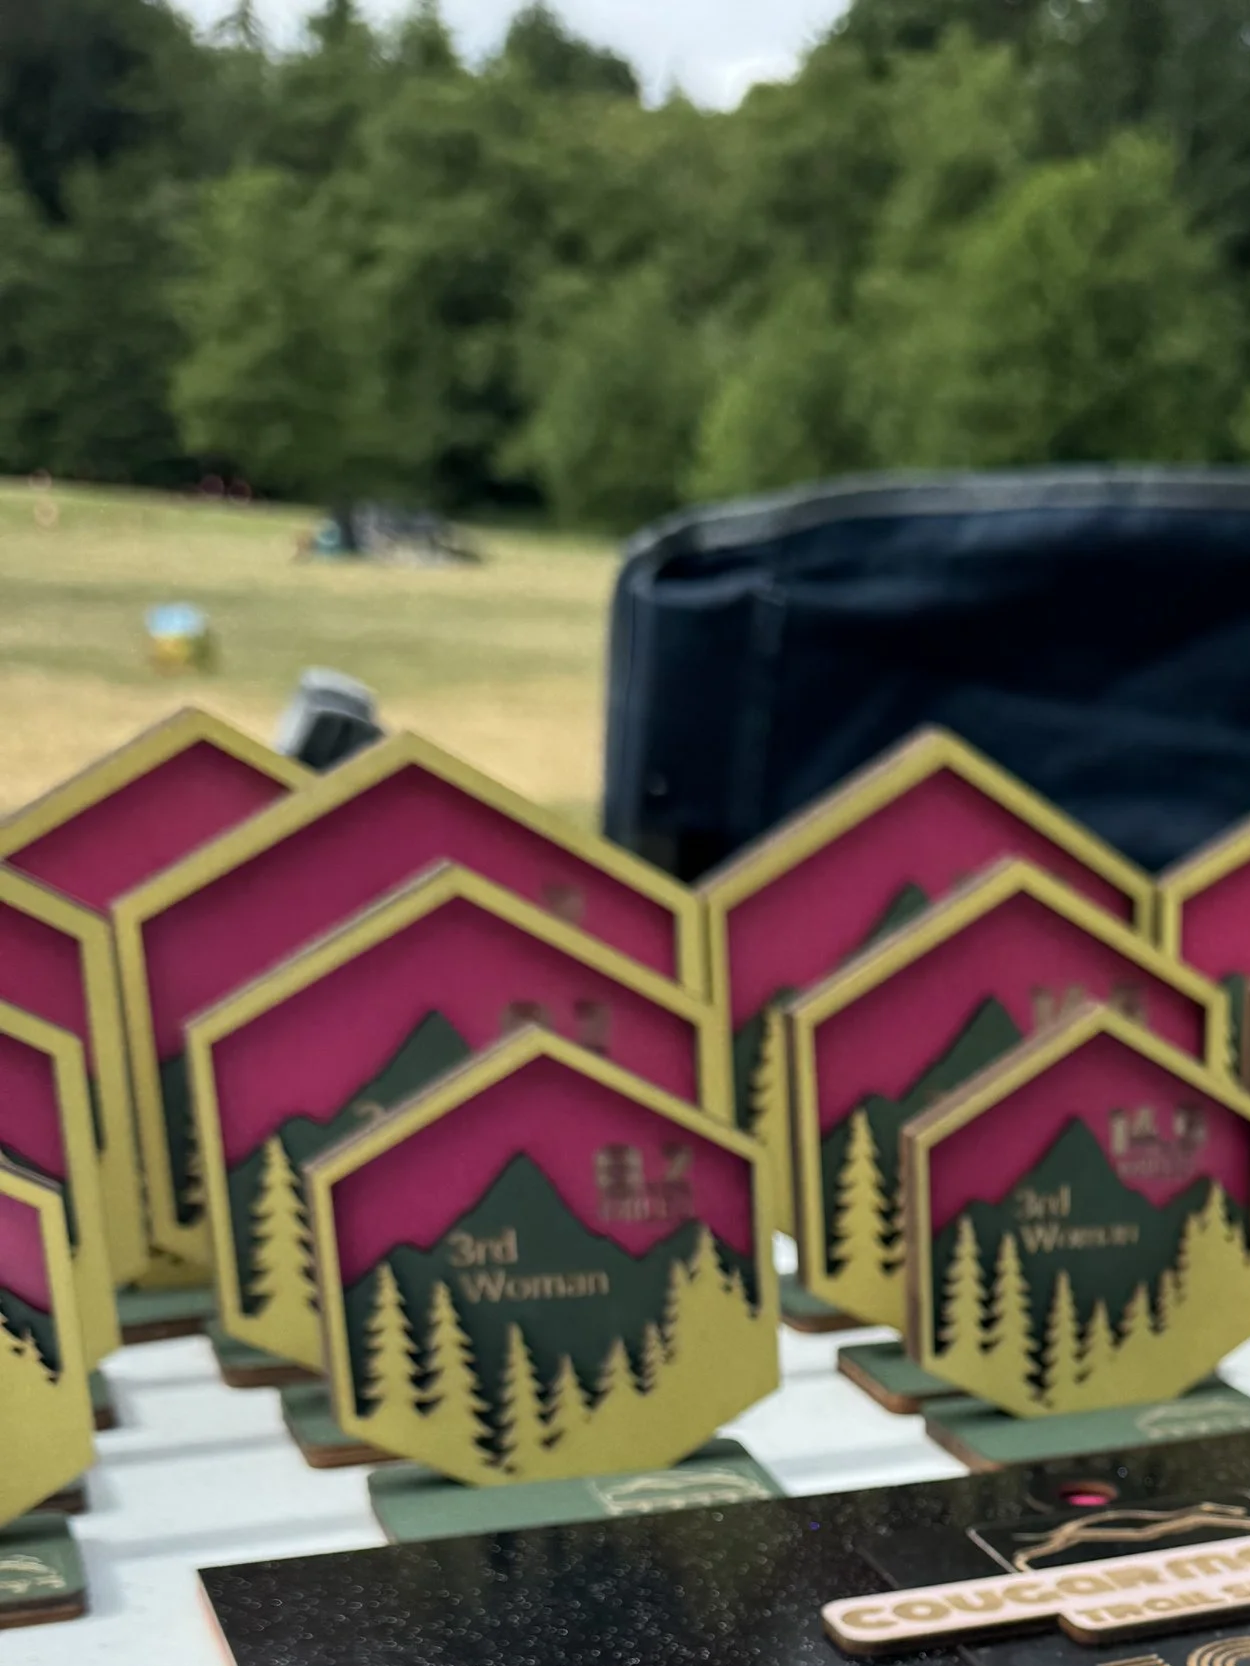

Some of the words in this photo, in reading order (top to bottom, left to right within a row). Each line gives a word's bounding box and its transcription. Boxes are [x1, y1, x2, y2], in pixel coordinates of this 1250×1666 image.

[1015, 1184, 1071, 1220] 3rd
[446, 1226, 519, 1268] 3rd
[1020, 1221, 1140, 1255] Woman
[458, 1268, 610, 1304] Woman
[842, 1565, 1161, 1630] COUGAR
